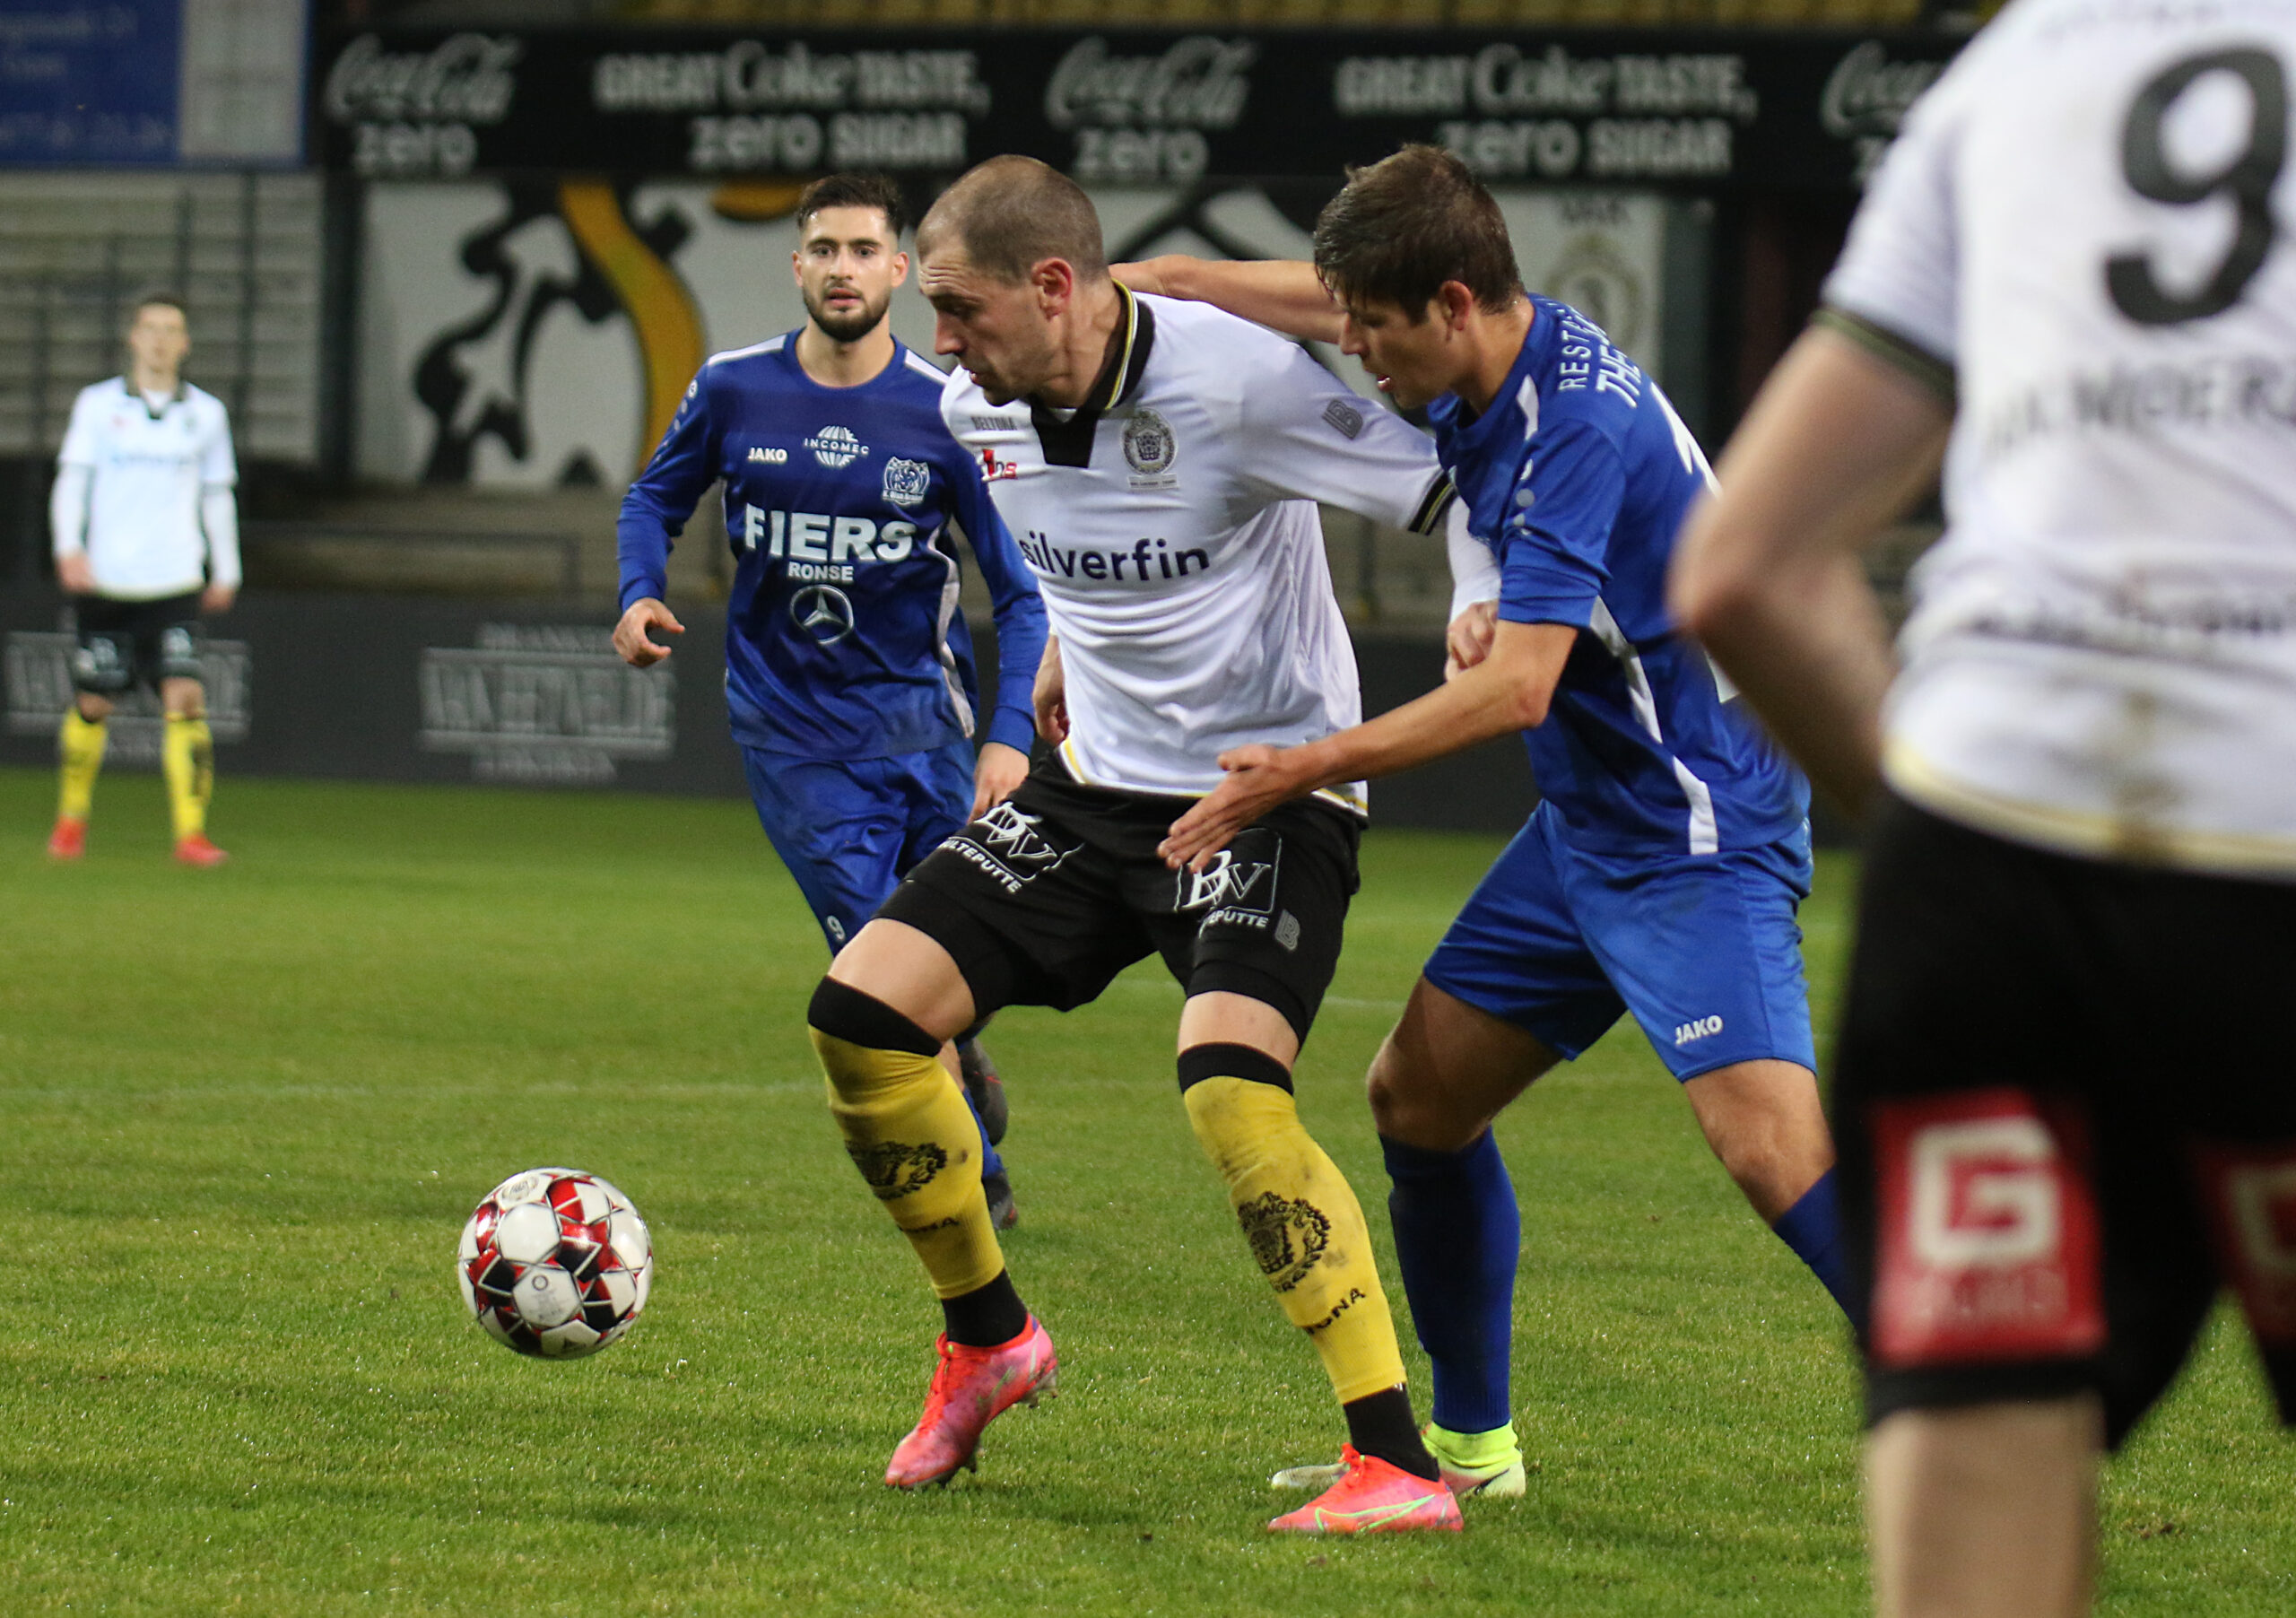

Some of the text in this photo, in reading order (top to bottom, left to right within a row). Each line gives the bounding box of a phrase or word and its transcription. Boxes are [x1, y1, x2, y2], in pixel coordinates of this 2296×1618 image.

[594, 51, 719, 109] GREAT
[721, 39, 852, 111] Coke
[1335, 56, 1470, 115] GREAT
[1472, 43, 1613, 117] Coke
[355, 120, 479, 172] zero
[691, 111, 969, 170] zero SUGAR
[1075, 128, 1210, 179] zero
[1439, 117, 1735, 174] zero SUGAR
[2104, 45, 2285, 326] 9
[747, 447, 787, 462] JAKO
[804, 437, 870, 455] INCOMEC
[744, 502, 918, 563] FIERS
[1019, 530, 1210, 581] silverfin
[788, 561, 854, 582] RONSE
[827, 915, 845, 940] 9
[1674, 1014, 1723, 1045] JAKO
